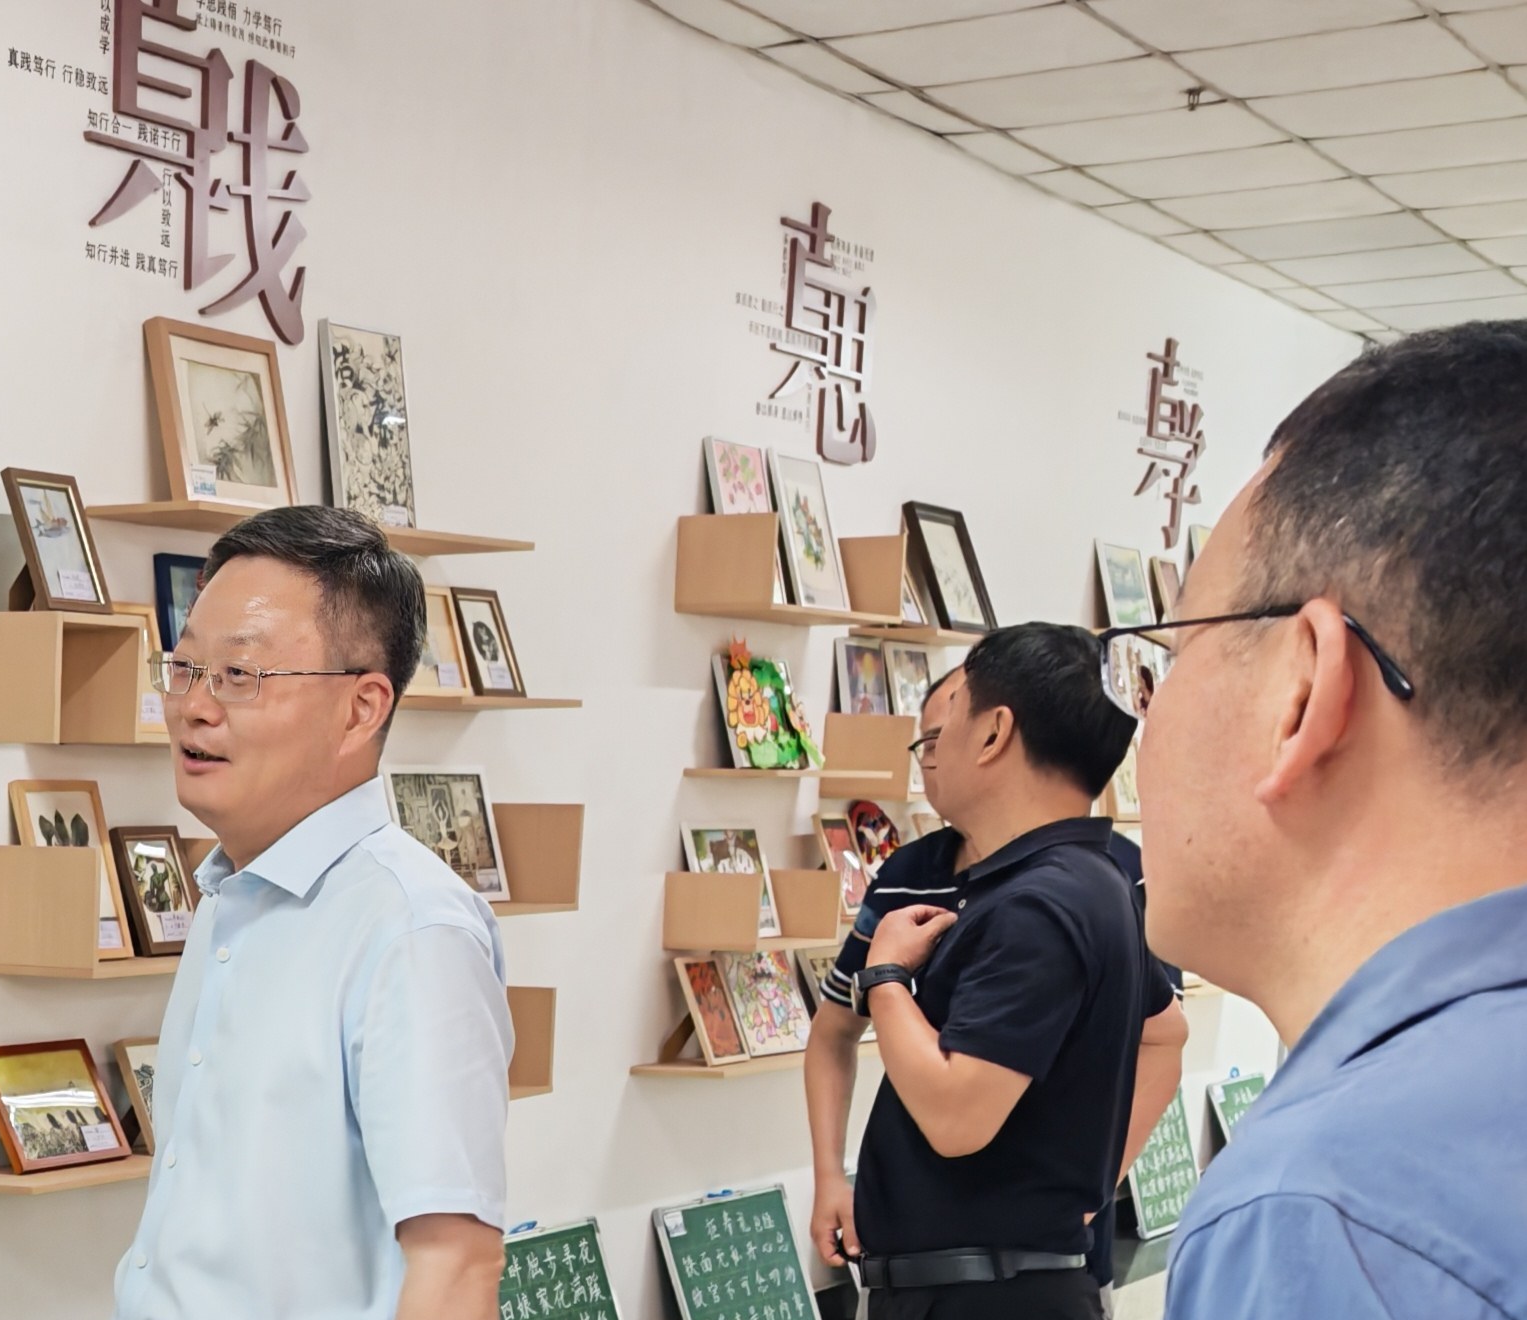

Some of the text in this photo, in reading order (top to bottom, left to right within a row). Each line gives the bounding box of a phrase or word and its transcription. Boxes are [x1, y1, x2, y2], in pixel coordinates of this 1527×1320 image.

[243, 6, 283, 37] 力学笃行
[7, 46, 110, 95] 真践笃行 行稳致远
[87, 108, 181, 152] 知行合一 践诺于行
[161, 168, 172, 249] 行以致远
[84, 240, 179, 279] 知行并进 践真笃行
[499, 1238, 596, 1287] 畔独步寻花
